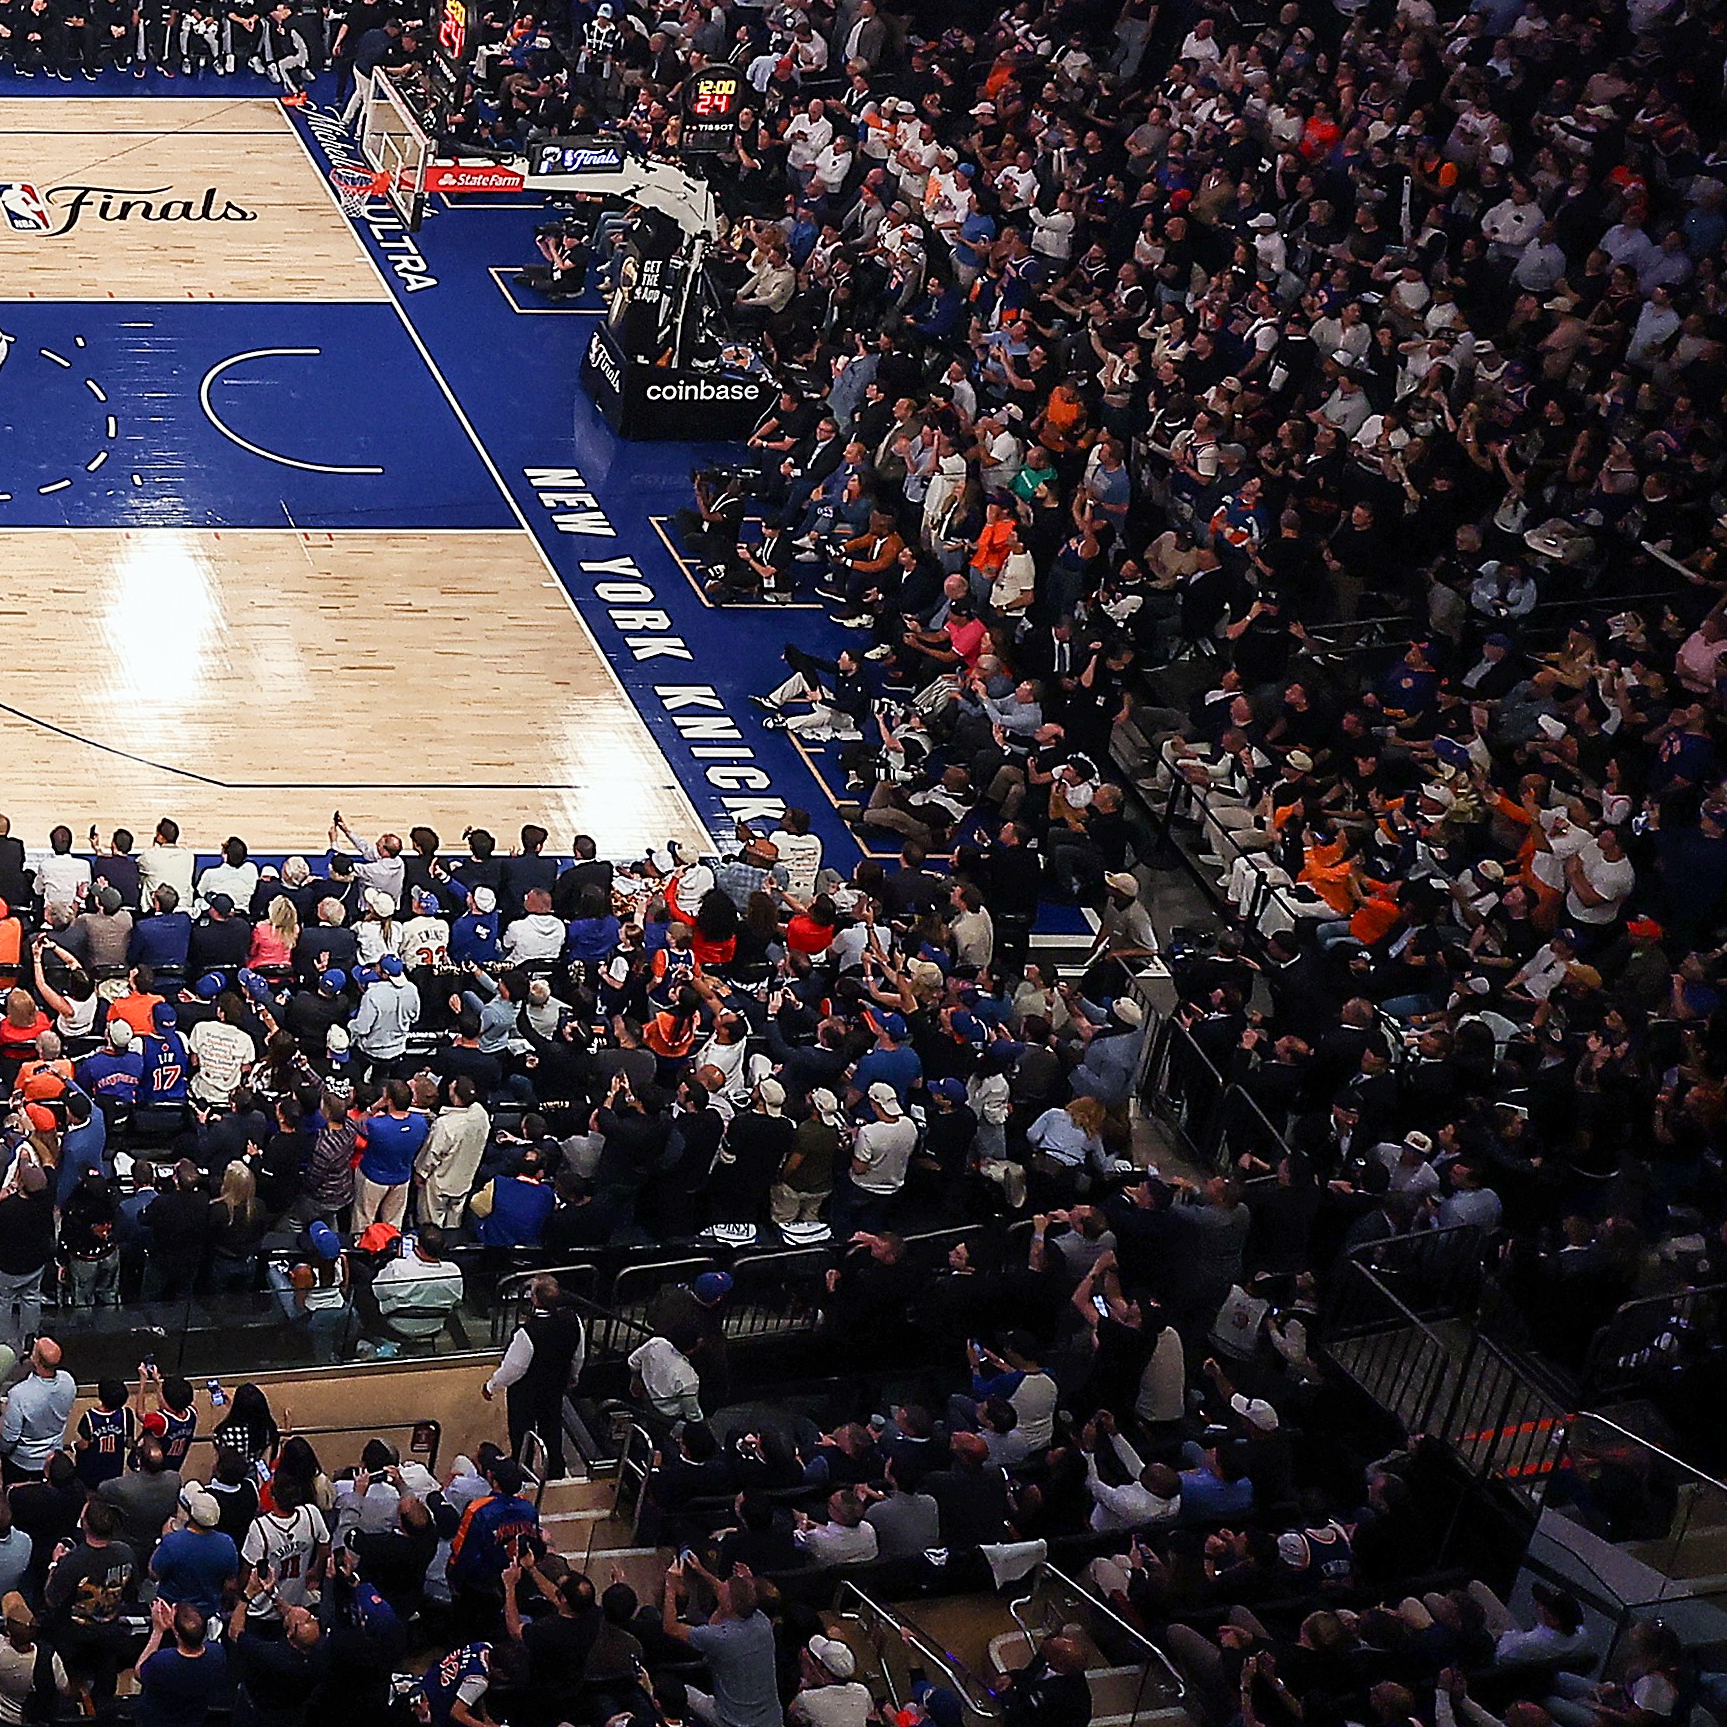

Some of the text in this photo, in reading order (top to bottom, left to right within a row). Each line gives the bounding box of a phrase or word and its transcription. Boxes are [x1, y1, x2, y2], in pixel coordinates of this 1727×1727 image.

[697, 80, 736, 95] 12:00
[695, 96, 728, 113] 24
[573, 149, 619, 171] Finals
[36, 185, 257, 237] Finals
[363, 201, 438, 292] ULTRA
[643, 260, 662, 273] GET
[642, 273, 659, 286] THE
[597, 344, 620, 393] Finals
[647, 380, 759, 400] coinbase
[523, 467, 787, 820] NEW YORK KNICK
[158, 1053, 175, 1065] LIN
[152, 1064, 182, 1091] 17
